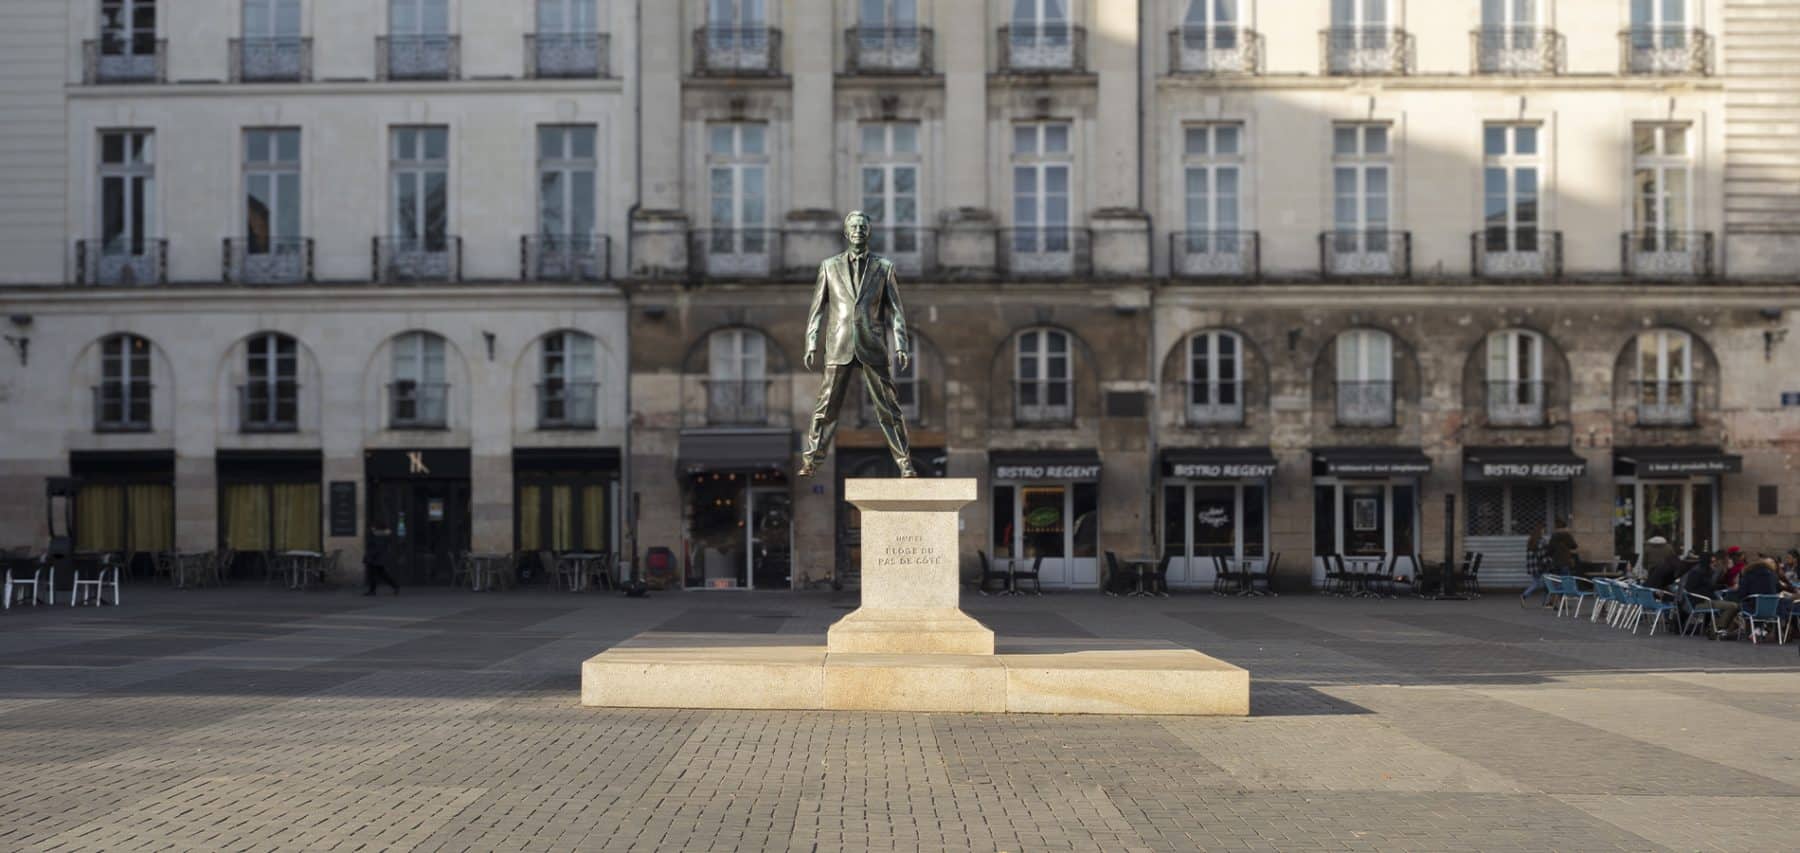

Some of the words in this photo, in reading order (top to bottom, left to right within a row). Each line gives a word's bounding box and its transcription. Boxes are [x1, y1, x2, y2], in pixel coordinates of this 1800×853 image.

[996, 465, 1044, 478] BISTRO
[1046, 465, 1099, 478] REGENT
[1174, 464, 1221, 477] BISTRO
[1223, 464, 1275, 477] REGENT
[1483, 463, 1530, 476] BISTRO
[1531, 463, 1584, 476] REGENT
[878, 557, 897, 566] PAS
[899, 557, 912, 565] DE
